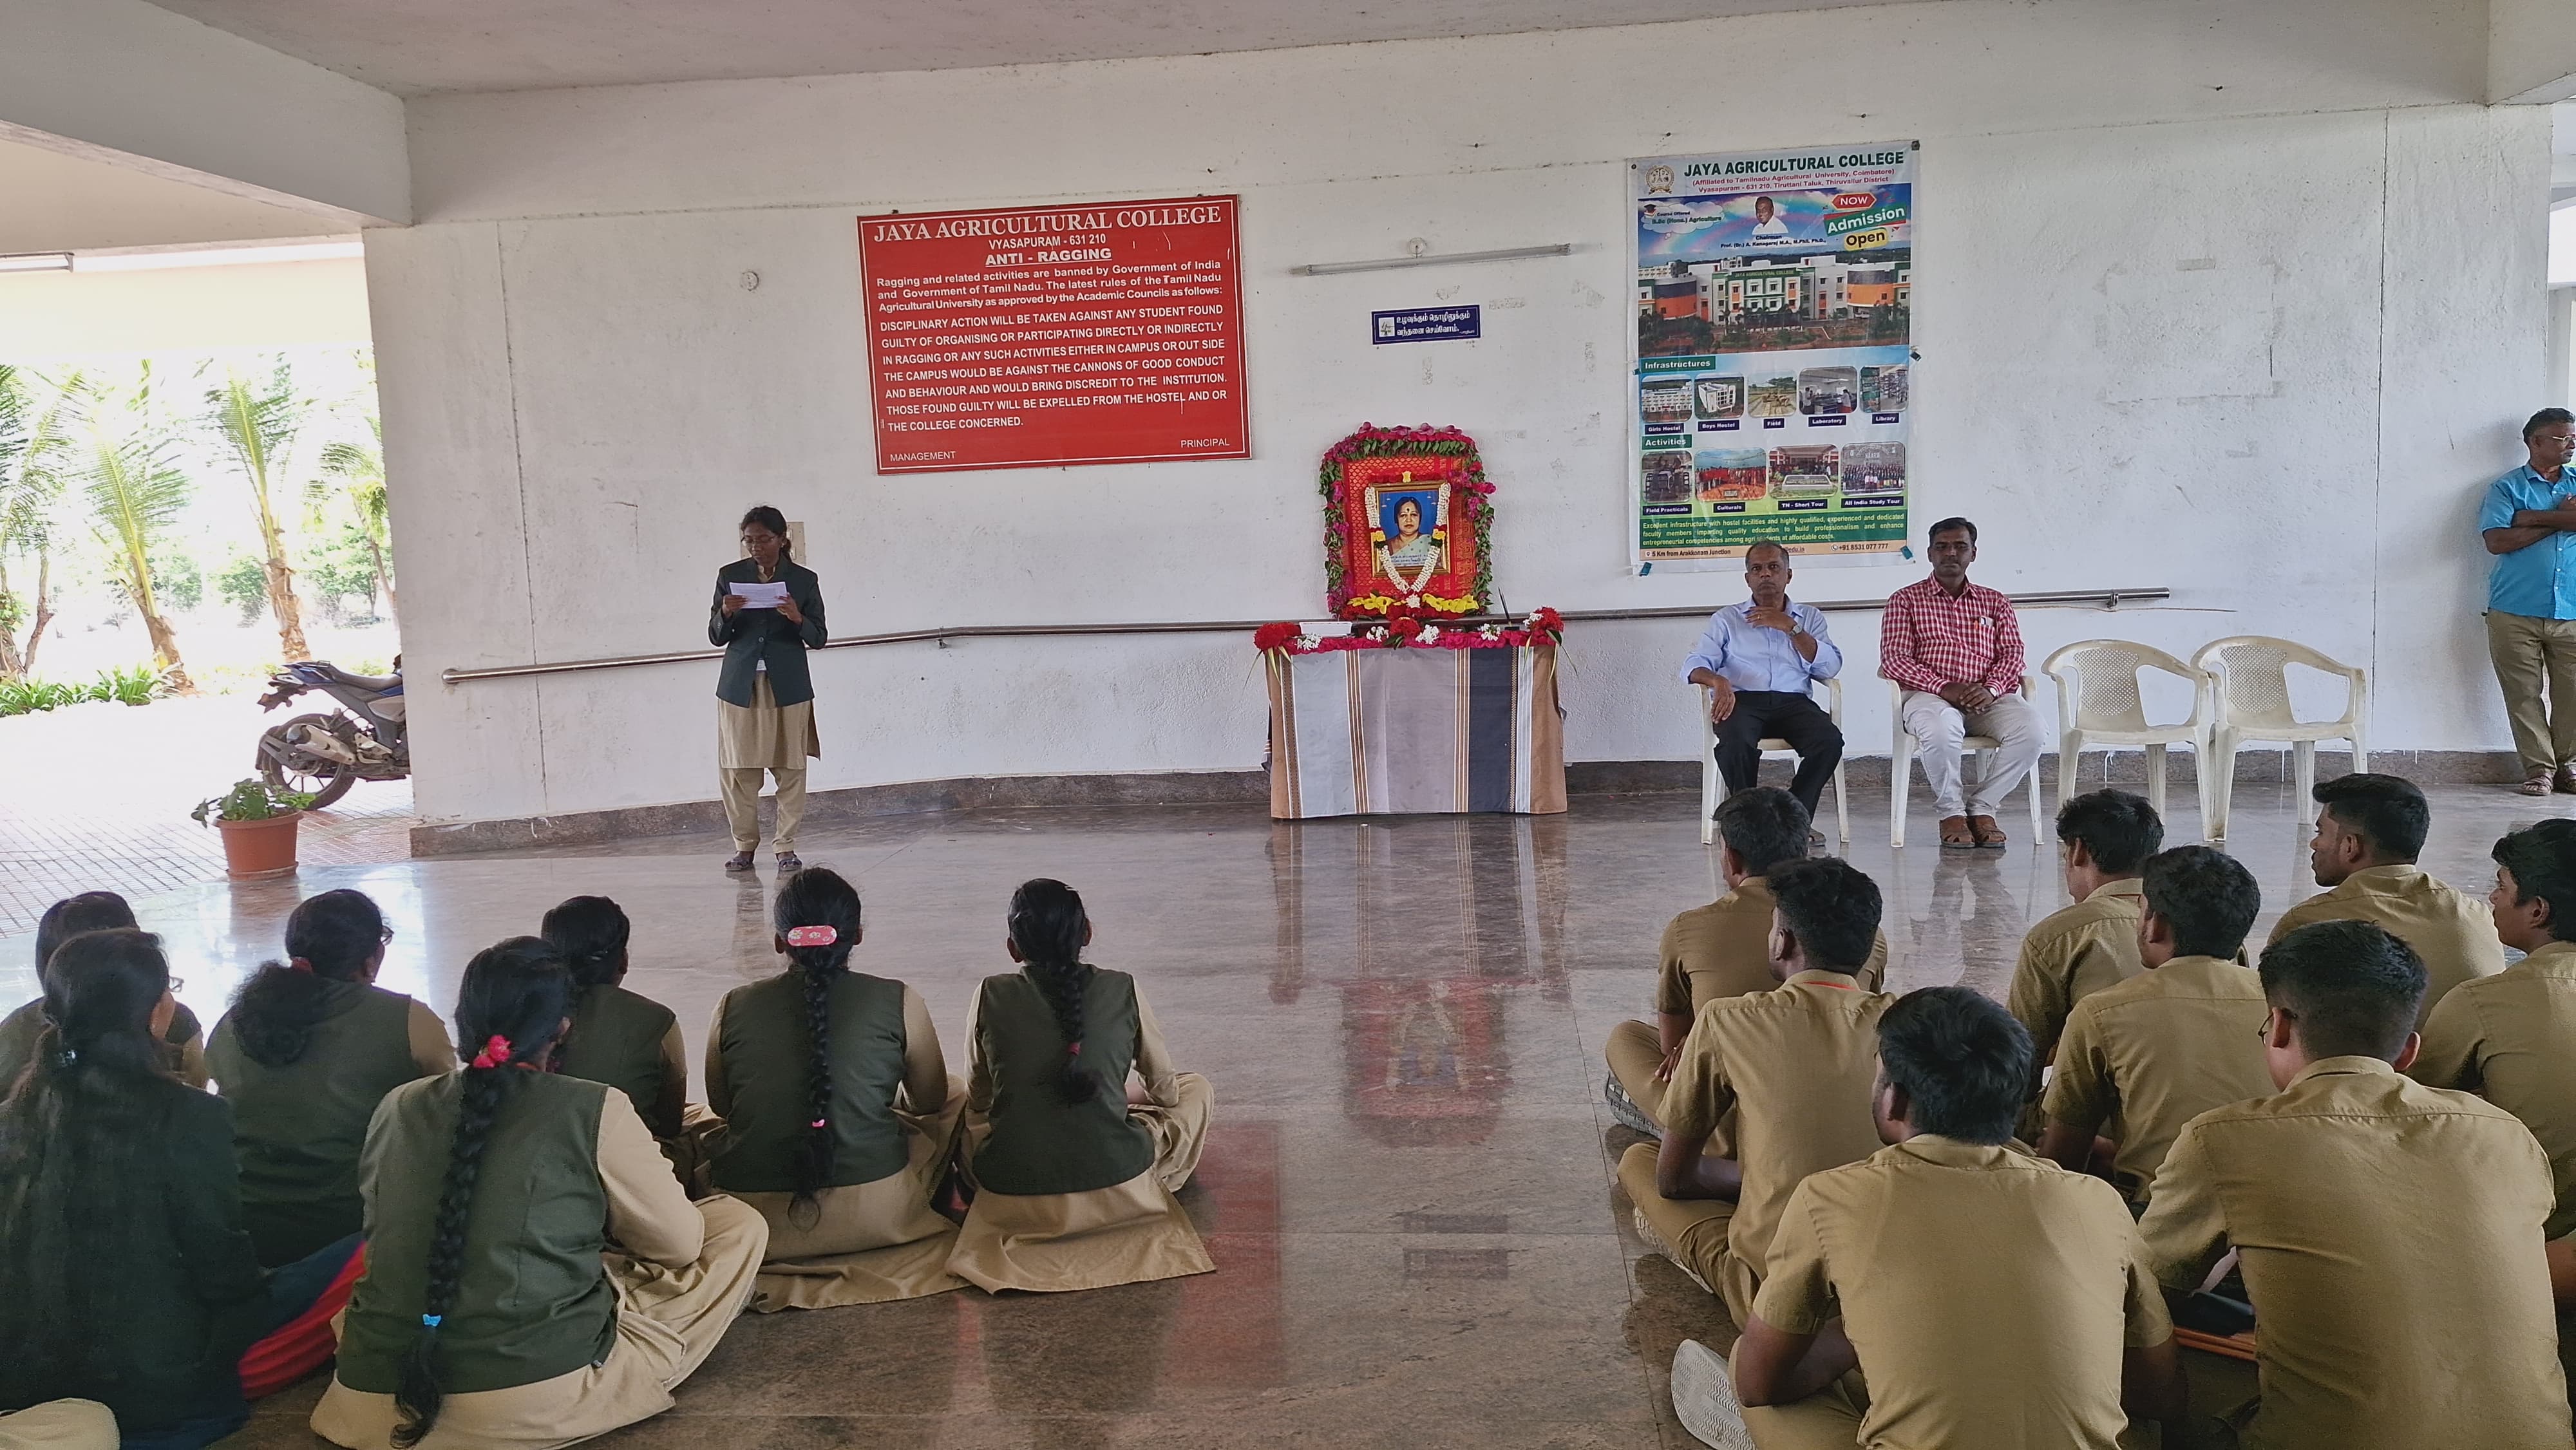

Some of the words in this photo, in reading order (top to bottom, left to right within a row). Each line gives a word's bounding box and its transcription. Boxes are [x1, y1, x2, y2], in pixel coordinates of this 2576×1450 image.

[1684, 163, 1721, 176] JAYA
[1725, 156, 1835, 174] AGRICULTURAL
[1839, 151, 1904, 167] COLLEGE
[1692, 178, 1725, 187] (Affiliated
[1772, 173, 1812, 182] Agricultural
[1852, 168, 1895, 176] Coimbatore)
[1841, 196, 1868, 205] NOW
[874, 223, 932, 242] JAYA
[935, 212, 1112, 238] AGRICULTURAL
[1117, 206, 1221, 228] COLLEGE
[1828, 207, 1905, 235] Admission
[989, 236, 1061, 250] VYASAPURAM
[1069, 234, 1085, 245] 631
[1089, 233, 1106, 244] 210
[1846, 232, 1885, 248] Open
[985, 252, 1023, 265] ANTI
[1037, 248, 1112, 262] RAGGING
[876, 277, 920, 288] Ragging
[923, 274, 942, 285] and
[945, 272, 980, 283] related
[983, 270, 1030, 281] activities
[1054, 266, 1093, 277] banned
[1096, 266, 1109, 276] by
[1112, 262, 1177, 274] Government
[1180, 261, 1191, 270] of
[1195, 259, 1220, 270] India
[878, 290, 897, 299] and
[903, 287, 967, 298] Government
[969, 285, 980, 294] of
[981, 283, 1010, 294] Tamil
[1014, 282, 1044, 292] Nadu.
[1045, 281, 1065, 290] The
[1068, 279, 1097, 289] latest
[1101, 278, 1126, 287] rules
[1130, 276, 1141, 286] of
[1144, 276, 1161, 285] the
[1163, 274, 1192, 284] Tamil
[1194, 272, 1221, 283] Nadu
[879, 300, 934, 314] Agricultural
[935, 298, 983, 308] University
[998, 294, 1044, 307] approved
[1045, 294, 1058, 305] by
[1059, 293, 1075, 302] the
[1076, 290, 1125, 301] Academic
[1126, 288, 1170, 298] Councils
[1184, 287, 1222, 296] follows:
[880, 319, 948, 332] DISCIPLINARY
[951, 316, 988, 328] ACTION
[990, 315, 1015, 325] WILL
[1017, 314, 1030, 324] BE
[1032, 312, 1066, 323] TAKEN
[1069, 310, 1113, 321] AGAINST
[1115, 308, 1136, 319] ANY
[1139, 306, 1185, 318] STUDENT
[1188, 305, 1223, 315] FOUND
[881, 337, 917, 348] GUILTY
[919, 337, 933, 346] OF
[935, 333, 998, 345] ORGANISING
[1000, 332, 1016, 342] OR
[1017, 328, 1093, 341] PARTICIPATING
[1095, 325, 1144, 337] DIRECTLY
[1146, 325, 1162, 335] OR
[1164, 321, 1223, 334] INDIRECTLY
[883, 355, 893, 365] IN
[895, 353, 942, 364] RAGGING
[943, 352, 958, 362] OR
[961, 351, 981, 361] ANY
[983, 349, 1011, 360] SUCH
[1013, 346, 1066, 358] ACTIVITIES
[1068, 344, 1104, 355] EITHER
[1106, 344, 1115, 353] IN
[1117, 342, 1160, 353] CAMPUS
[1162, 341, 1177, 351] OR
[1178, 340, 1199, 350] OUT
[1202, 339, 1225, 349] SIDE
[884, 372, 904, 382] THE
[905, 370, 948, 381] CAMPUS
[949, 368, 987, 379] WOULD
[989, 366, 1003, 377] BE
[1005, 364, 1049, 375] AGAINST
[1050, 363, 1071, 373] THE
[1073, 361, 1122, 372] CANNONS
[1125, 360, 1139, 370] OF
[1142, 359, 1172, 369] GOOD
[1175, 355, 1225, 368] CONDUCT
[886, 388, 906, 399] AND
[909, 386, 967, 397] BEHAVIOUR
[969, 384, 990, 395] AND
[992, 382, 1029, 393] WOULD
[1032, 381, 1063, 391] BRING
[1065, 378, 1118, 390] DISCREDIT
[1120, 377, 1134, 387] TO
[1137, 376, 1157, 386] THE
[1162, 373, 1227, 385] INSTITUTION.
[886, 404, 920, 415] THOSE
[922, 403, 956, 413] FOUND
[959, 400, 994, 411] GUILTY
[996, 400, 1021, 410] WILL
[1023, 399, 1037, 408] BE
[1039, 396, 1090, 408] EXPELLED
[1093, 395, 1121, 405] FROM
[1123, 393, 1144, 404] THE
[1146, 392, 1186, 402] HOSTEL
[1188, 391, 1209, 400] AND
[1212, 390, 1227, 399] OR
[887, 422, 907, 432] THE
[909, 420, 956, 431] COLLEGE
[958, 417, 1023, 429] CONCERNED.
[1180, 438, 1229, 448] PRINCIPAL
[1645, 437, 1686, 446] Activities
[890, 451, 956, 462] MANAGEMENT
